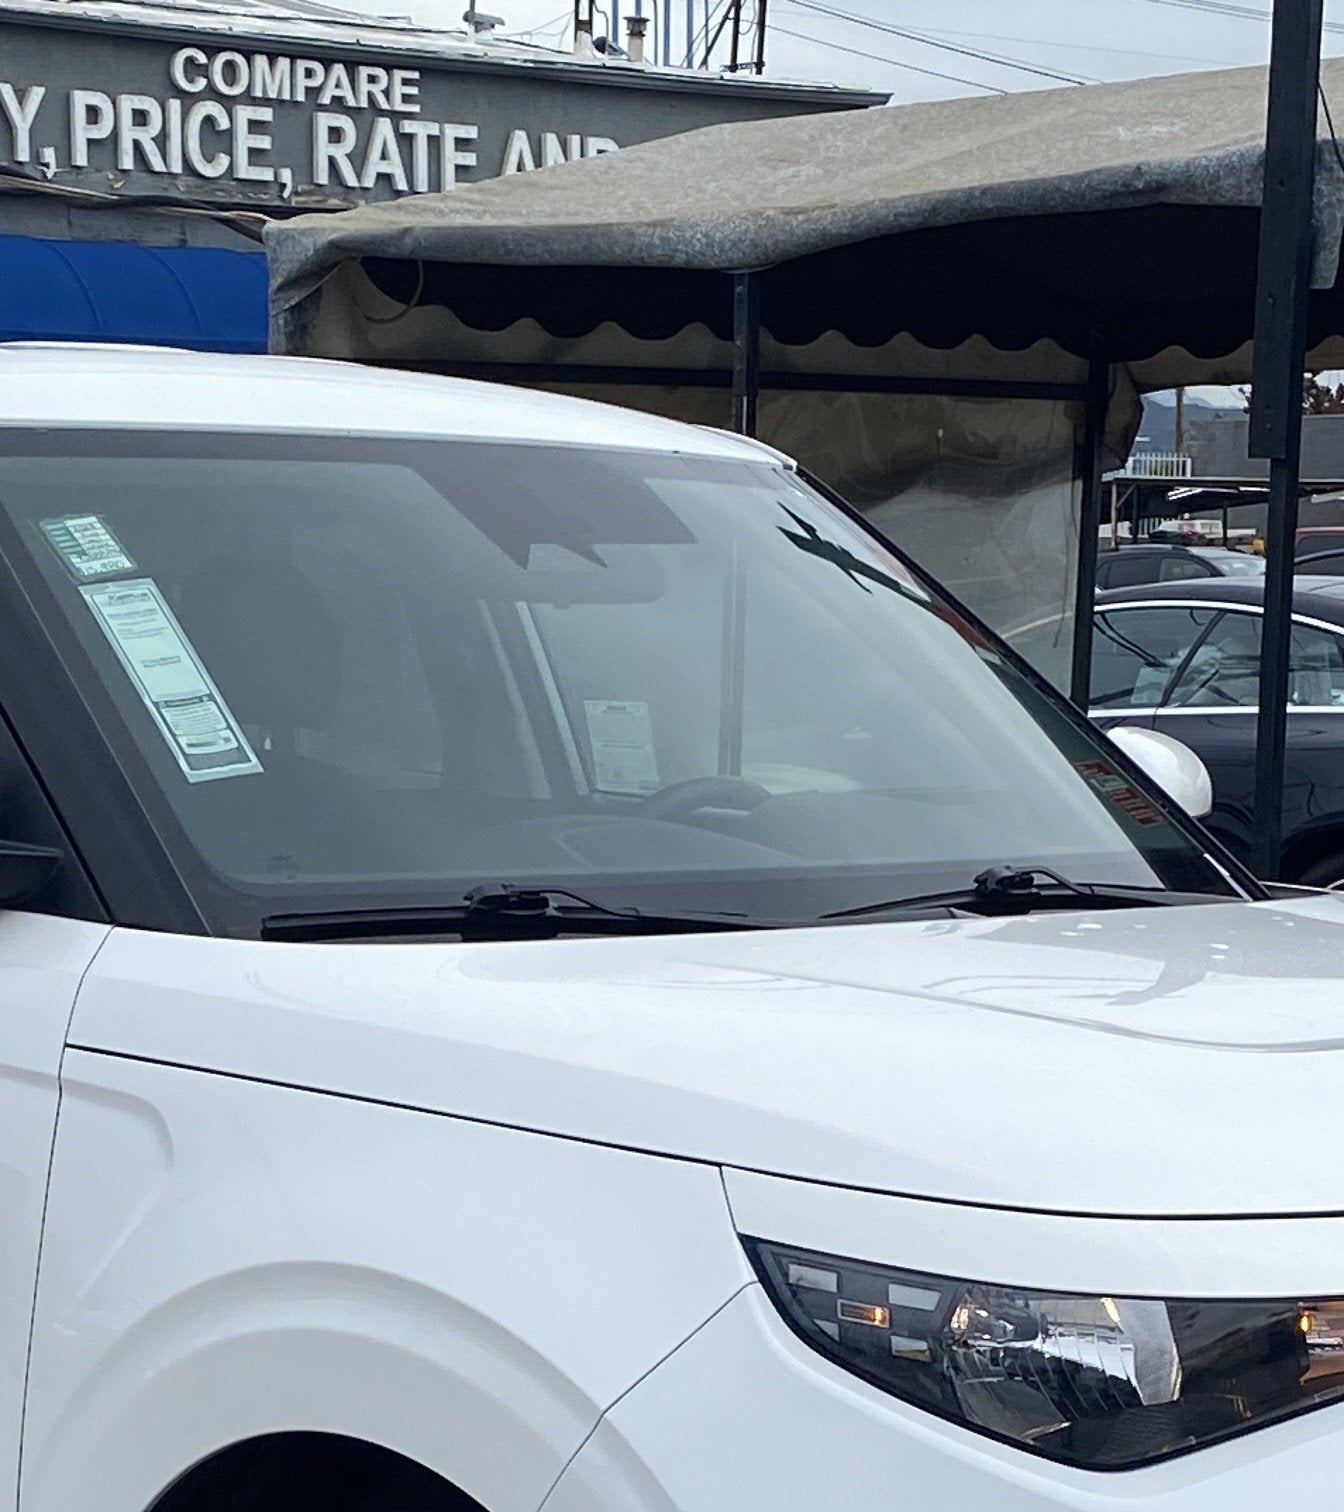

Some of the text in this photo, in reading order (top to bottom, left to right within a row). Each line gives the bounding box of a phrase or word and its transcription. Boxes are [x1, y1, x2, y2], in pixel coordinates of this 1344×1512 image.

[170, 47, 420, 113] COMPARE
[69, 89, 293, 200] PRICE,
[313, 112, 479, 194] RATE
